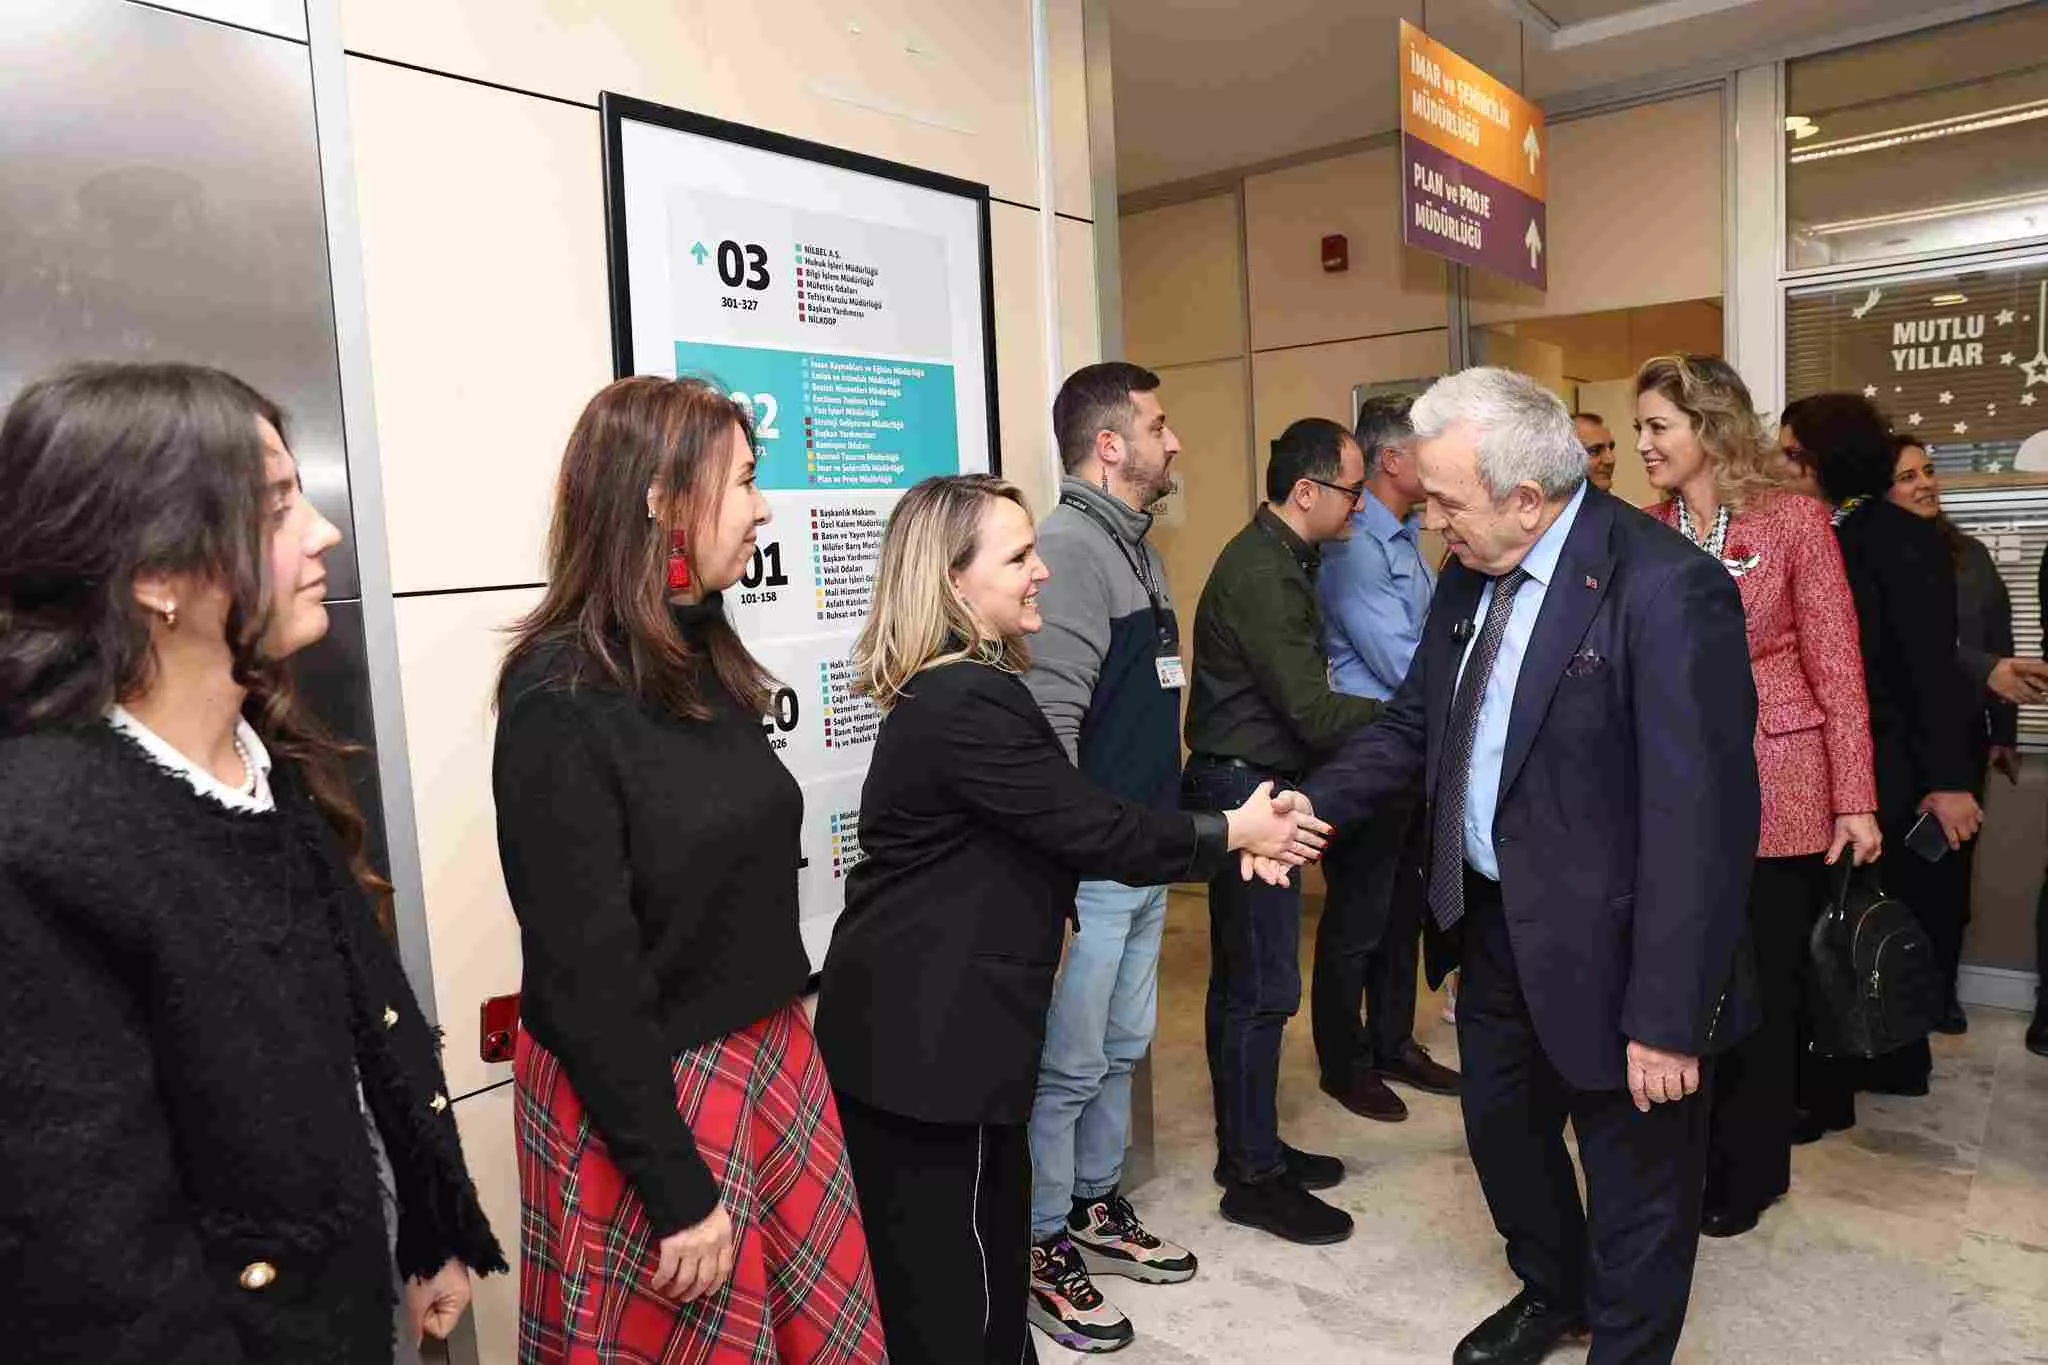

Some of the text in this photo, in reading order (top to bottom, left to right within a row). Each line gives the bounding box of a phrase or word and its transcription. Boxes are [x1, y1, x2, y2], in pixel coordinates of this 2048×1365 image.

[1409, 43, 1440, 88] İMAR
[1412, 88, 1480, 147] MÜDÜRLÜĞÜ
[1413, 162, 1491, 219] PLAN ve PROJE
[1415, 200, 1482, 250] MÜDÜRLÜĞÜ
[717, 239, 770, 292] 03
[805, 256, 826, 267] Hukuk
[845, 263, 879, 277] Müdürlüğü
[806, 269, 821, 280] Bilgi
[840, 274, 874, 287] Müdürlüğü
[720, 296, 759, 311] 301-327
[808, 303, 831, 314] Başkan
[849, 297, 882, 310] Müdürlüğü
[1892, 314, 1985, 346] MUTLU
[1890, 342, 1984, 372] YILLAR
[820, 519, 835, 528] Özel
[821, 531, 839, 541] Basın
[739, 541, 788, 589] 01
[822, 553, 846, 564] Başkan
[740, 592, 777, 604] 101-158
[825, 587, 839, 597] Mali
[825, 599, 844, 609] Asfalt
[826, 611, 849, 620] Ruhsat
